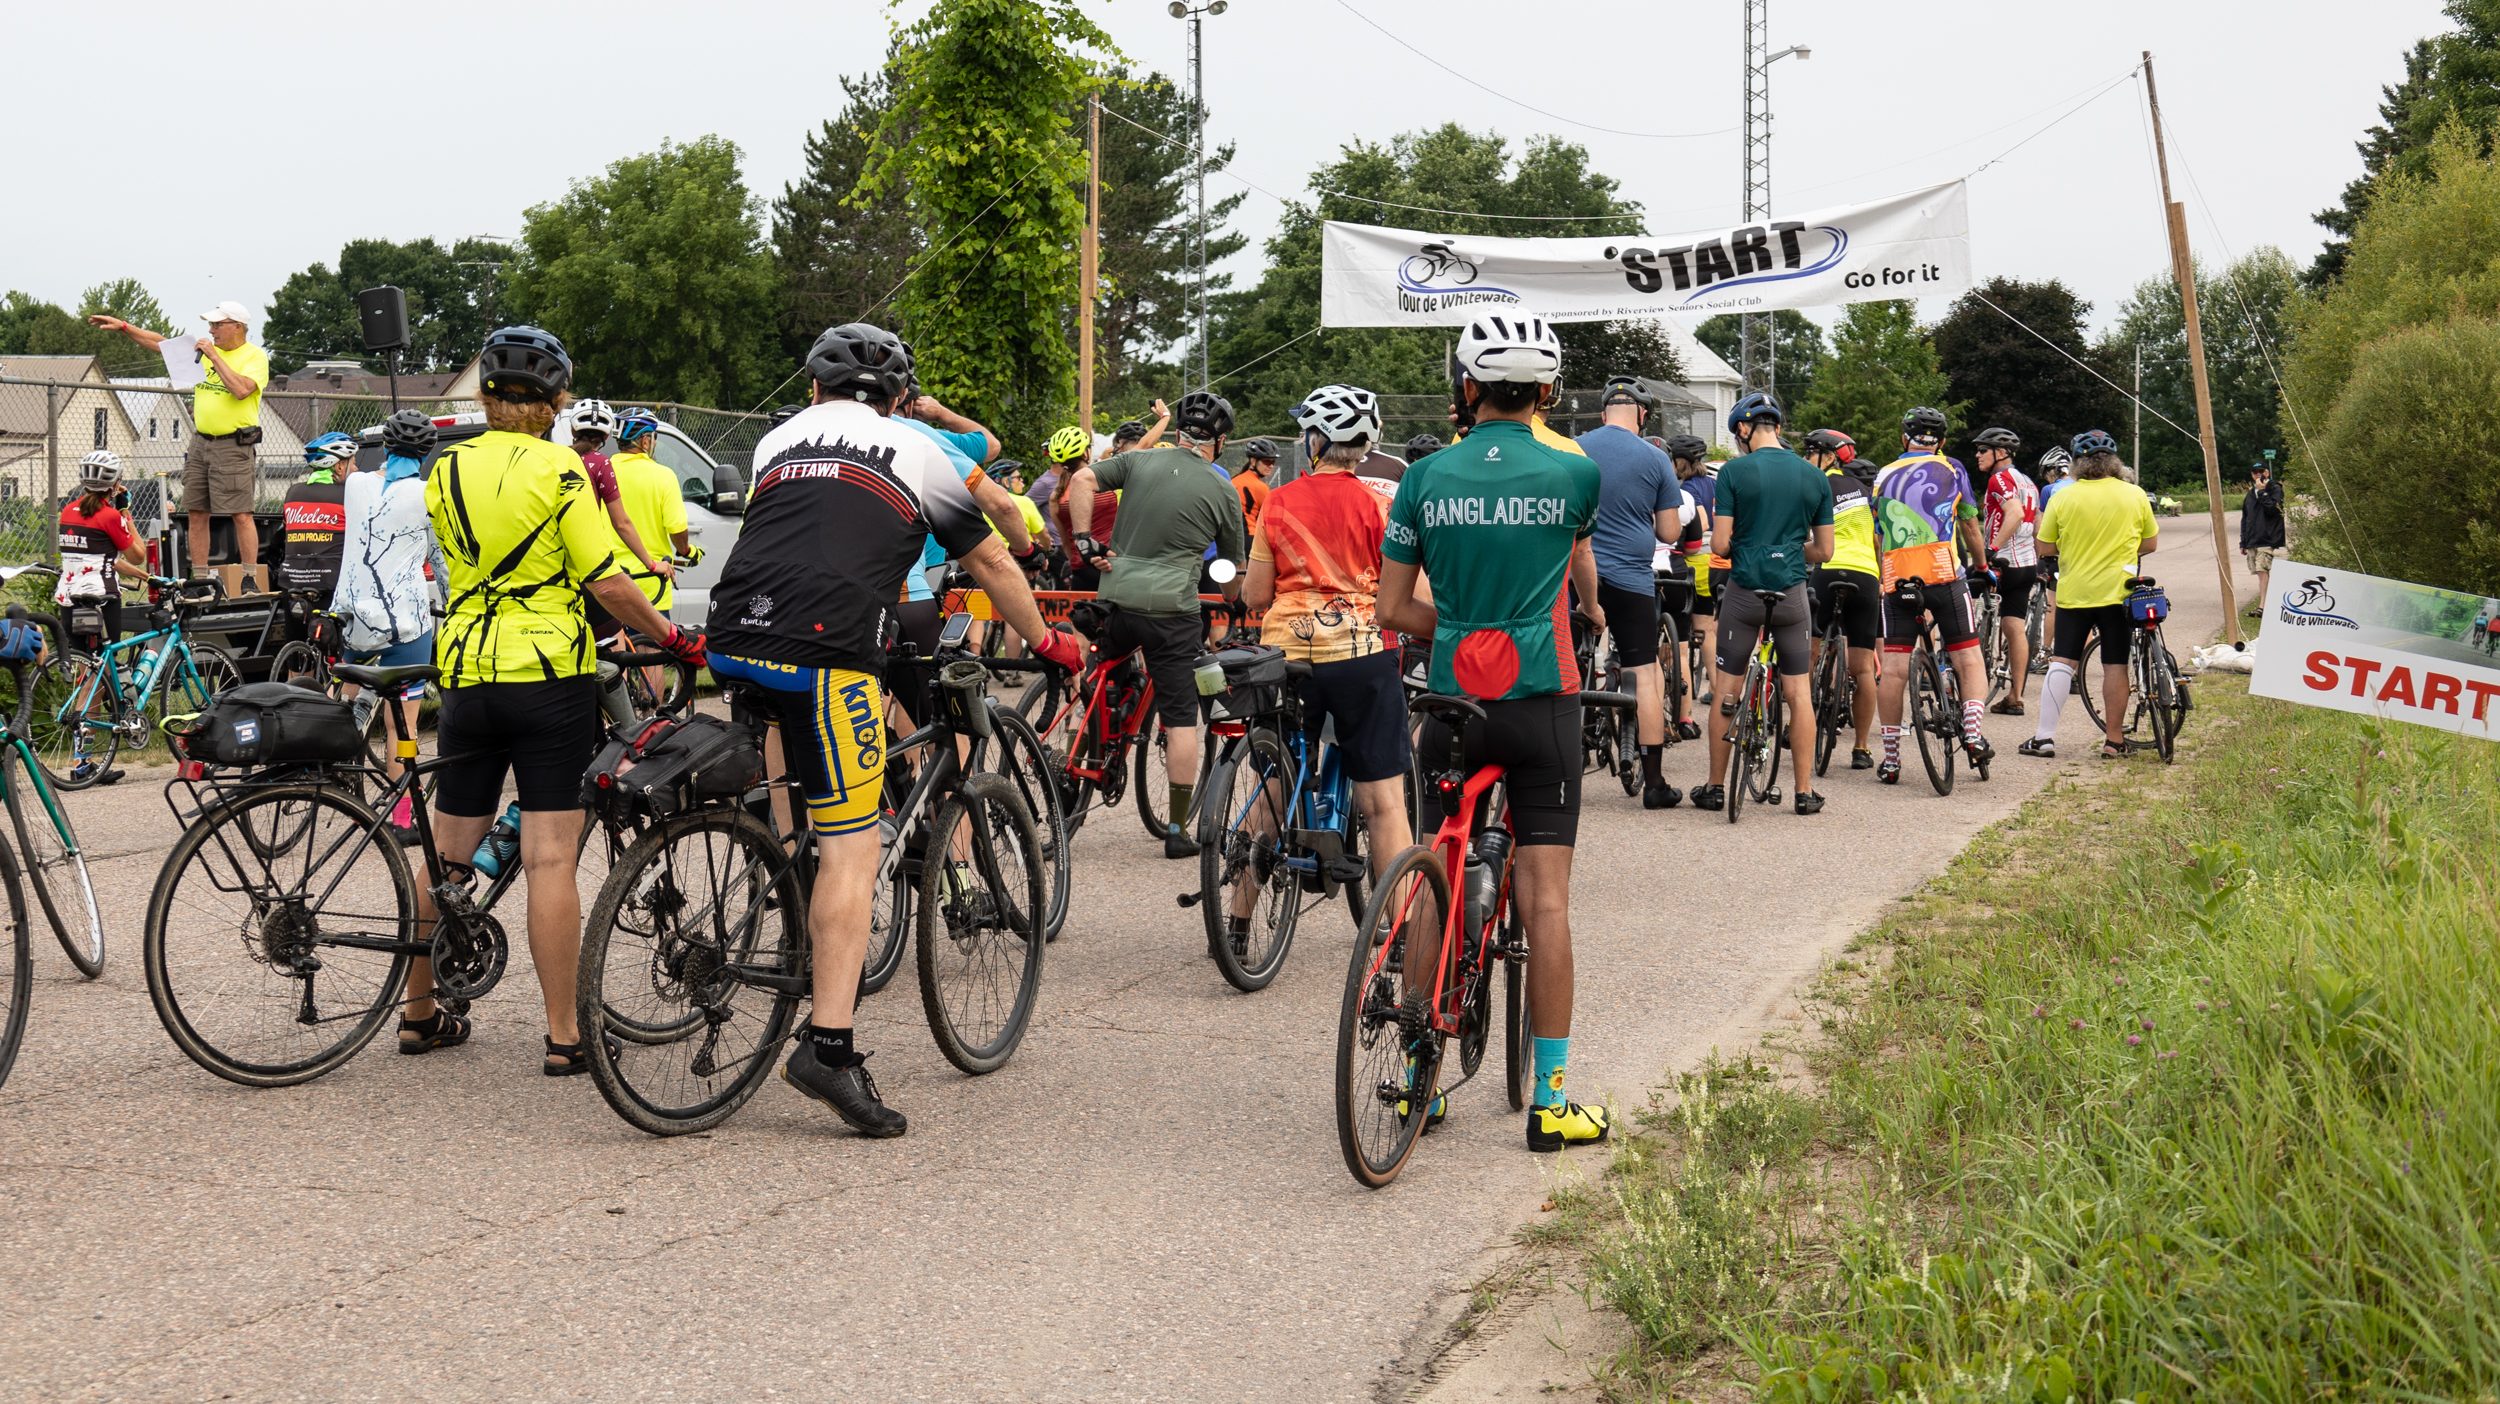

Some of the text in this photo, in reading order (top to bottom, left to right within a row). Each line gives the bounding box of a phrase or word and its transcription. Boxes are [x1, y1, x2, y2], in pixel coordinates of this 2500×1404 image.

[1620, 221, 1806, 294] START
[1844, 263, 1941, 289] Go for it
[1396, 285, 1521, 313] Tour de Whitewater
[1550, 306, 1600, 318] sponsored
[1602, 306, 1615, 318] by
[1616, 304, 1665, 316] Riverview
[1667, 301, 1705, 313] Seniors
[1706, 298, 1736, 310] Social
[1738, 296, 1763, 307] Club
[780, 462, 840, 481] OTTAWA
[285, 505, 339, 525] Wheelers
[1423, 497, 1566, 528] BANGLADESH
[306, 532, 334, 543] PROJECT
[2280, 605, 2360, 631] Tour de Whitewater
[2302, 650, 2500, 721] START
[813, 1034, 844, 1046] FILA
